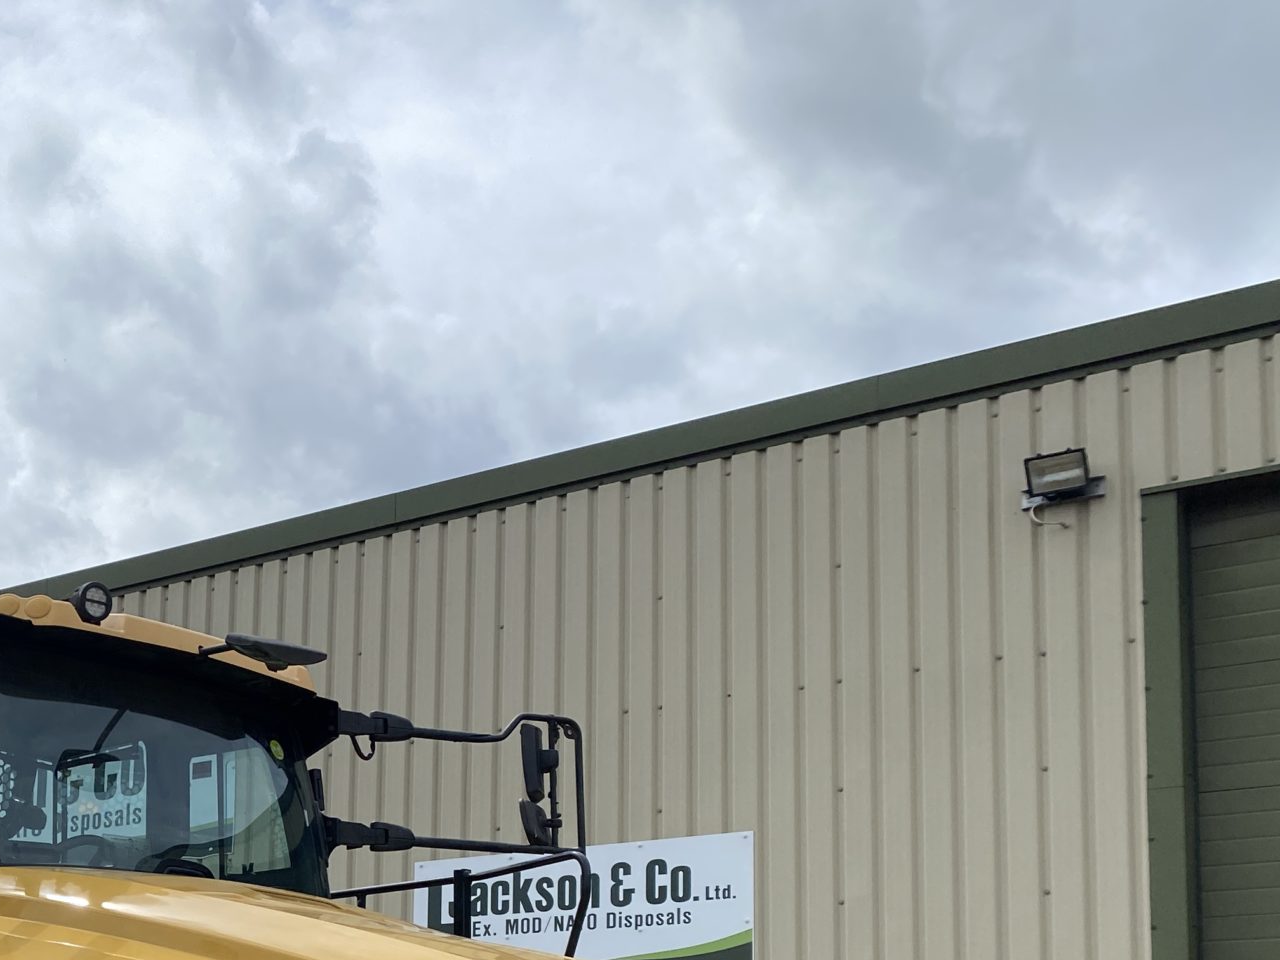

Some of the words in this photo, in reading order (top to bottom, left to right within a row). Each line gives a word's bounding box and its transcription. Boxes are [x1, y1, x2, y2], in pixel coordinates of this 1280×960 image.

[610, 861, 636, 908] &
[472, 920, 497, 938] Ex.
[505, 913, 598, 935] MOD/NAO
[605, 908, 692, 931] Disposals
